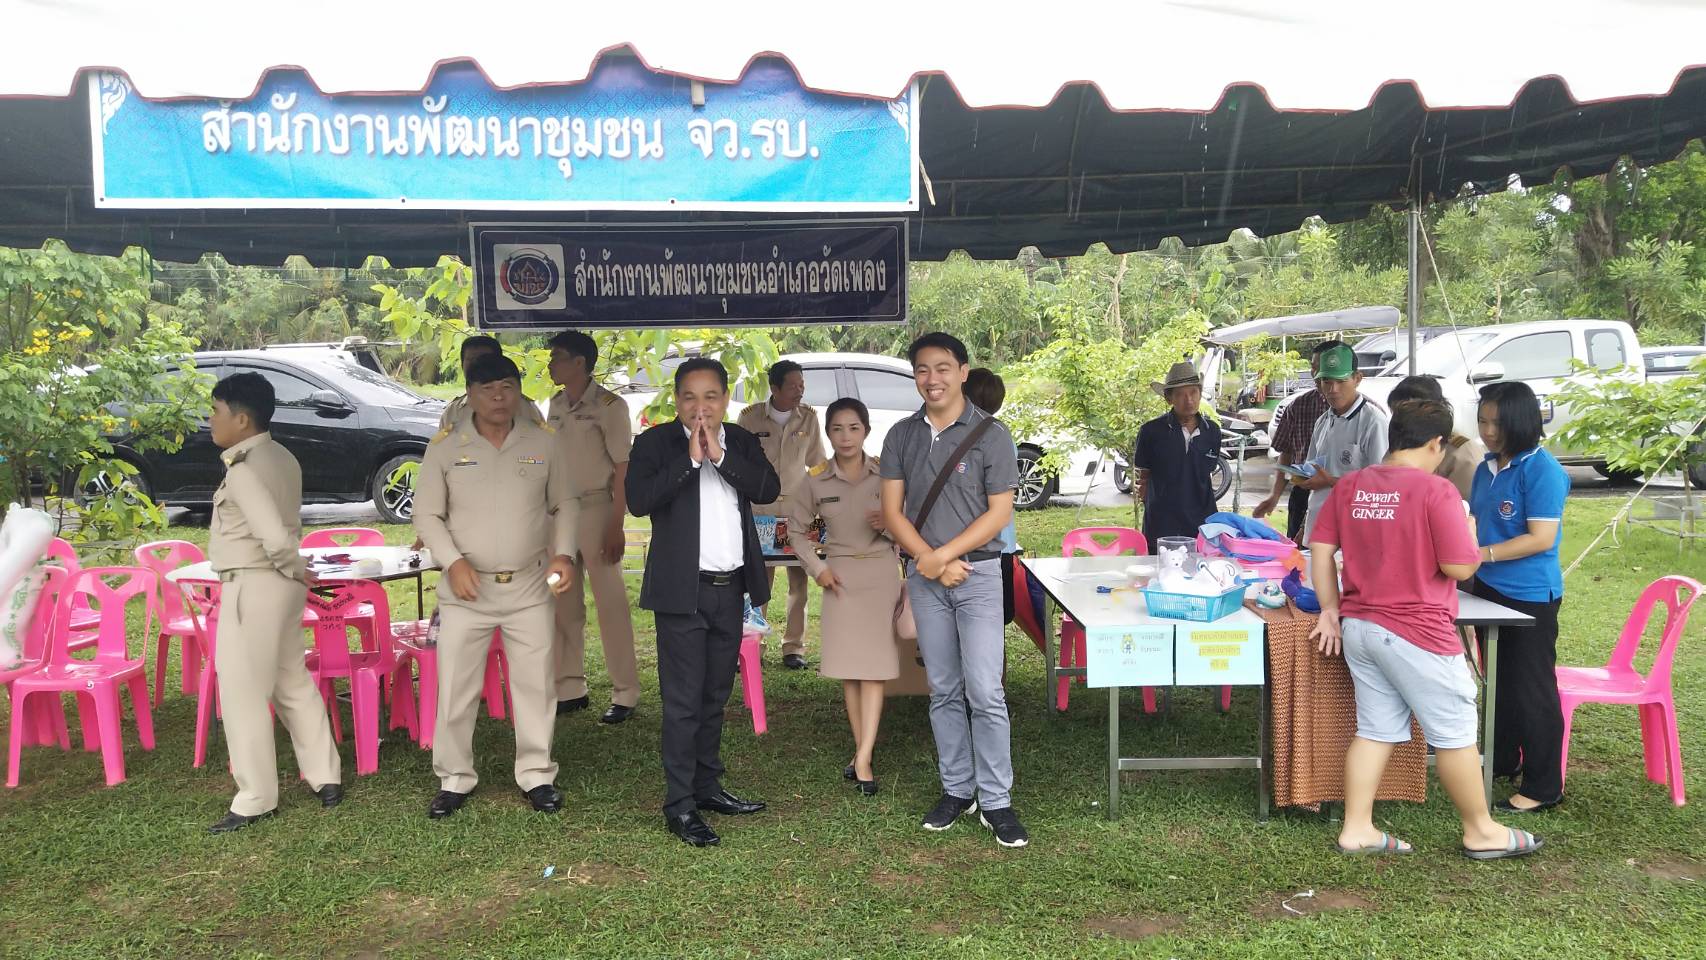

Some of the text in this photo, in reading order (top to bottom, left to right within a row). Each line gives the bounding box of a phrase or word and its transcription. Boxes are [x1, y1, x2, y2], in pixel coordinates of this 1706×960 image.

[202, 92, 819, 179] สำนักงานพัฒนาชุมชน จว.รบ.
[573, 244, 888, 314] สำนักงานพัฒนาชุมชนอำเภอวัดเพลง
[1352, 508, 1395, 520] GINGER
[1354, 490, 1401, 503] Dewar's
